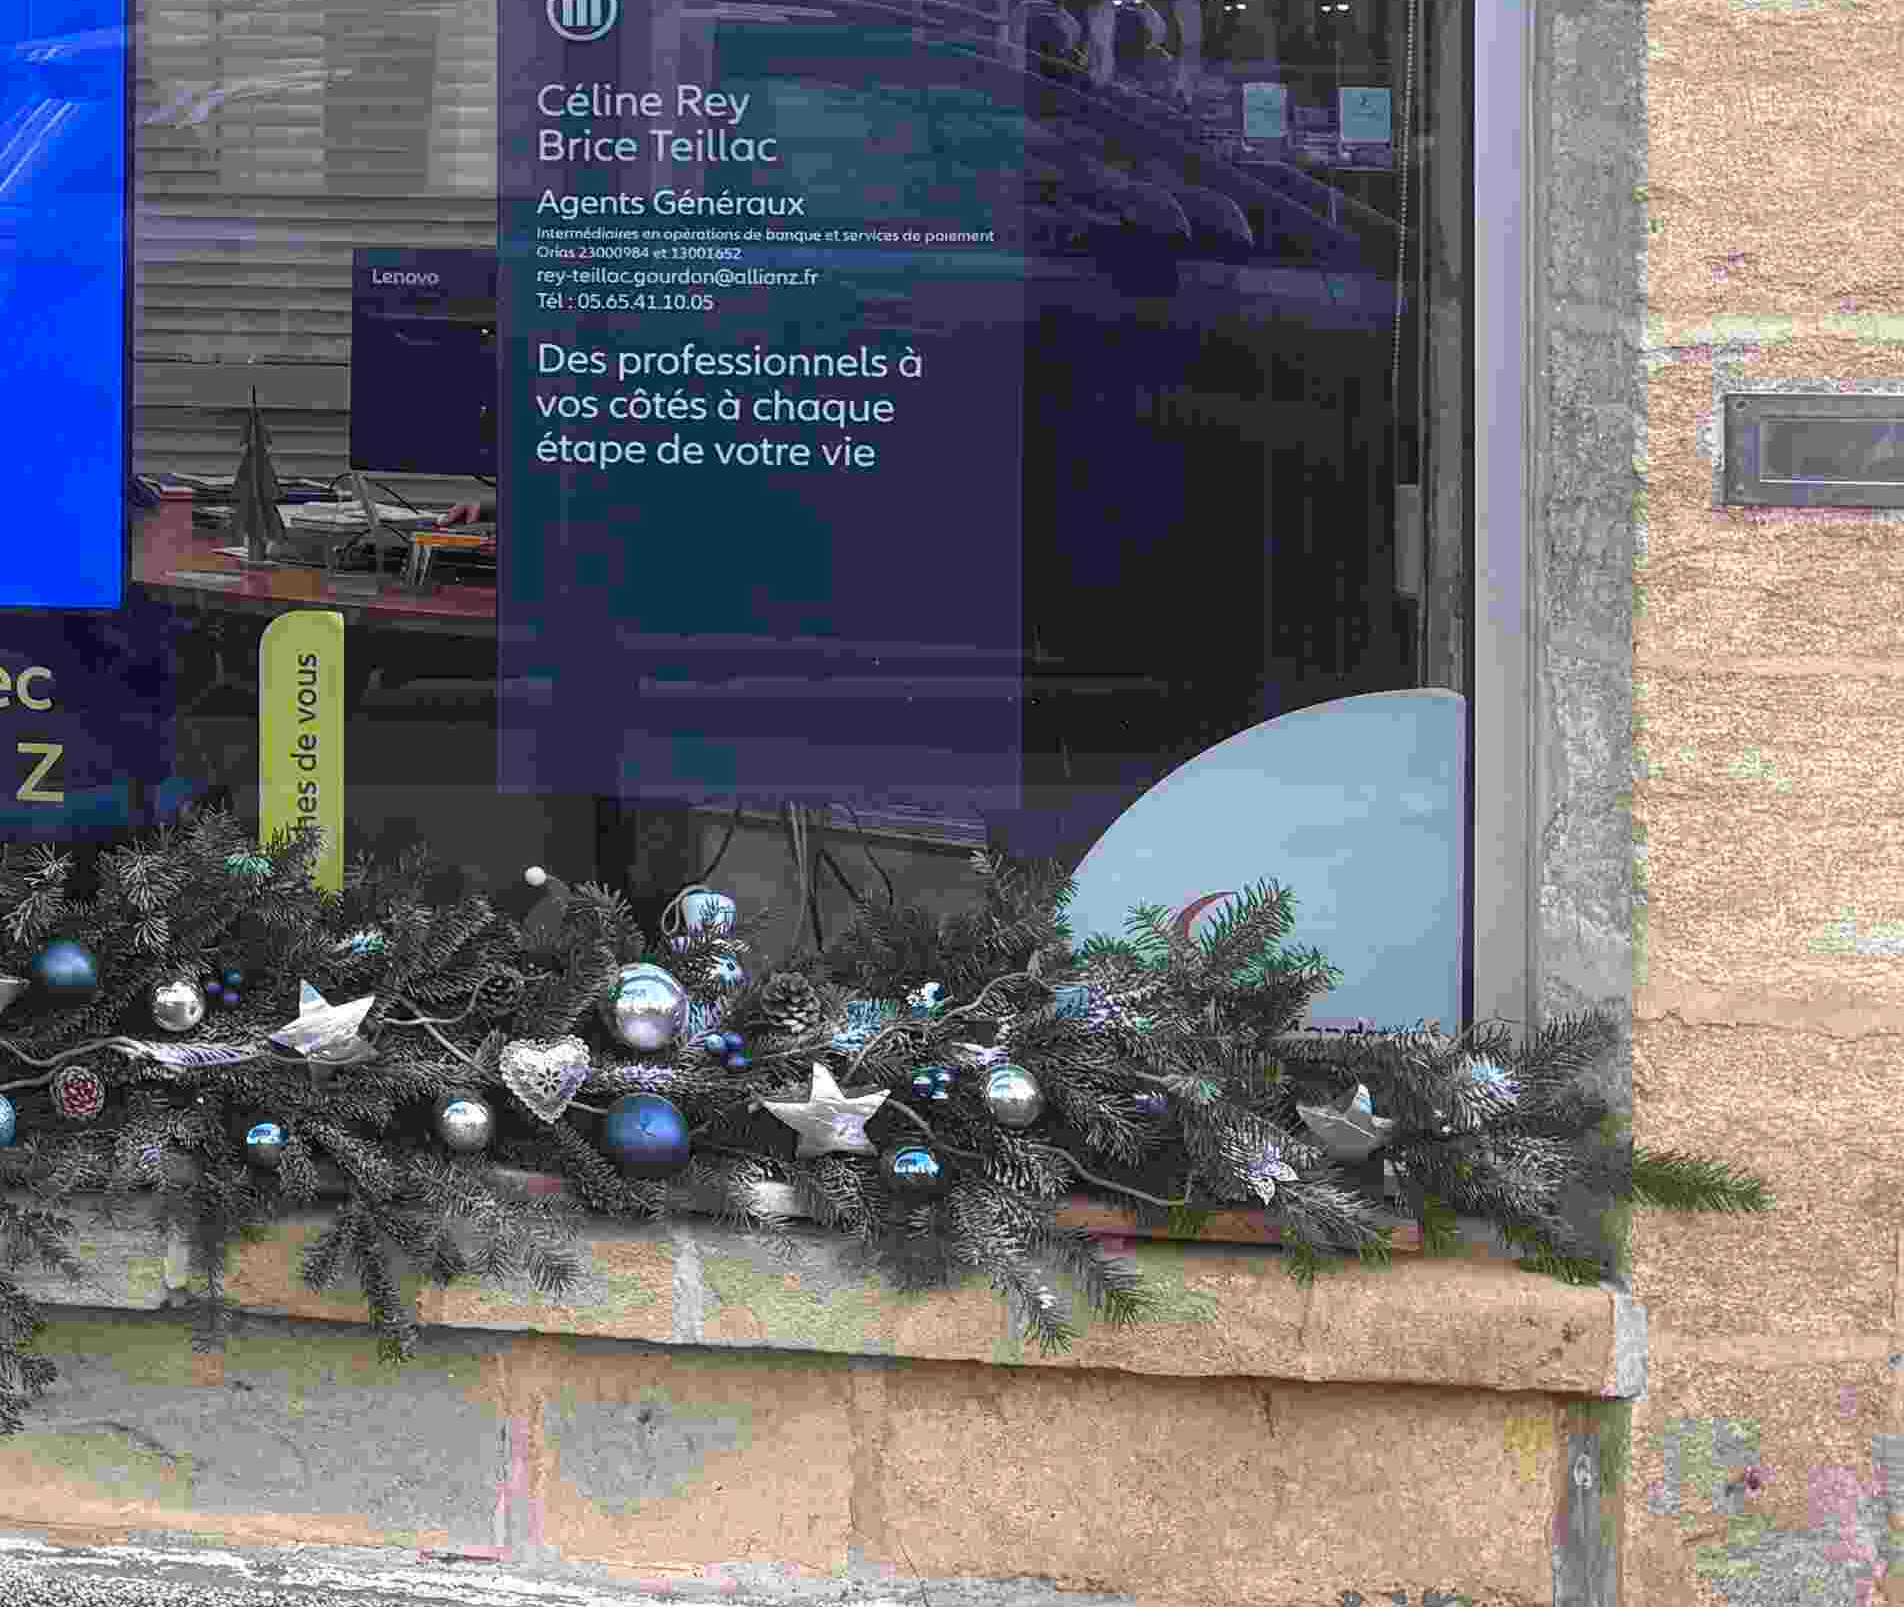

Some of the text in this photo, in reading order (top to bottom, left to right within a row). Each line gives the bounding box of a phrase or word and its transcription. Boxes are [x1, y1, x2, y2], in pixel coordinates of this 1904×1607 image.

[535, 82, 751, 126] Céline Rey
[536, 128, 778, 163] Brice Teillac
[535, 189, 806, 221] Agents Généraux
[535, 225, 996, 247] Intermédiaires en opérations de banque et services de paiement
[654, 247, 669, 261] et
[371, 268, 441, 285] Lenovo
[537, 343, 924, 382] Des professionnels à
[536, 389, 896, 429] vos côtés à chaque
[536, 432, 877, 469] étape de votre vie
[296, 651, 318, 725] vous
[288, 732, 318, 772] de
[15, 741, 66, 803] Z
